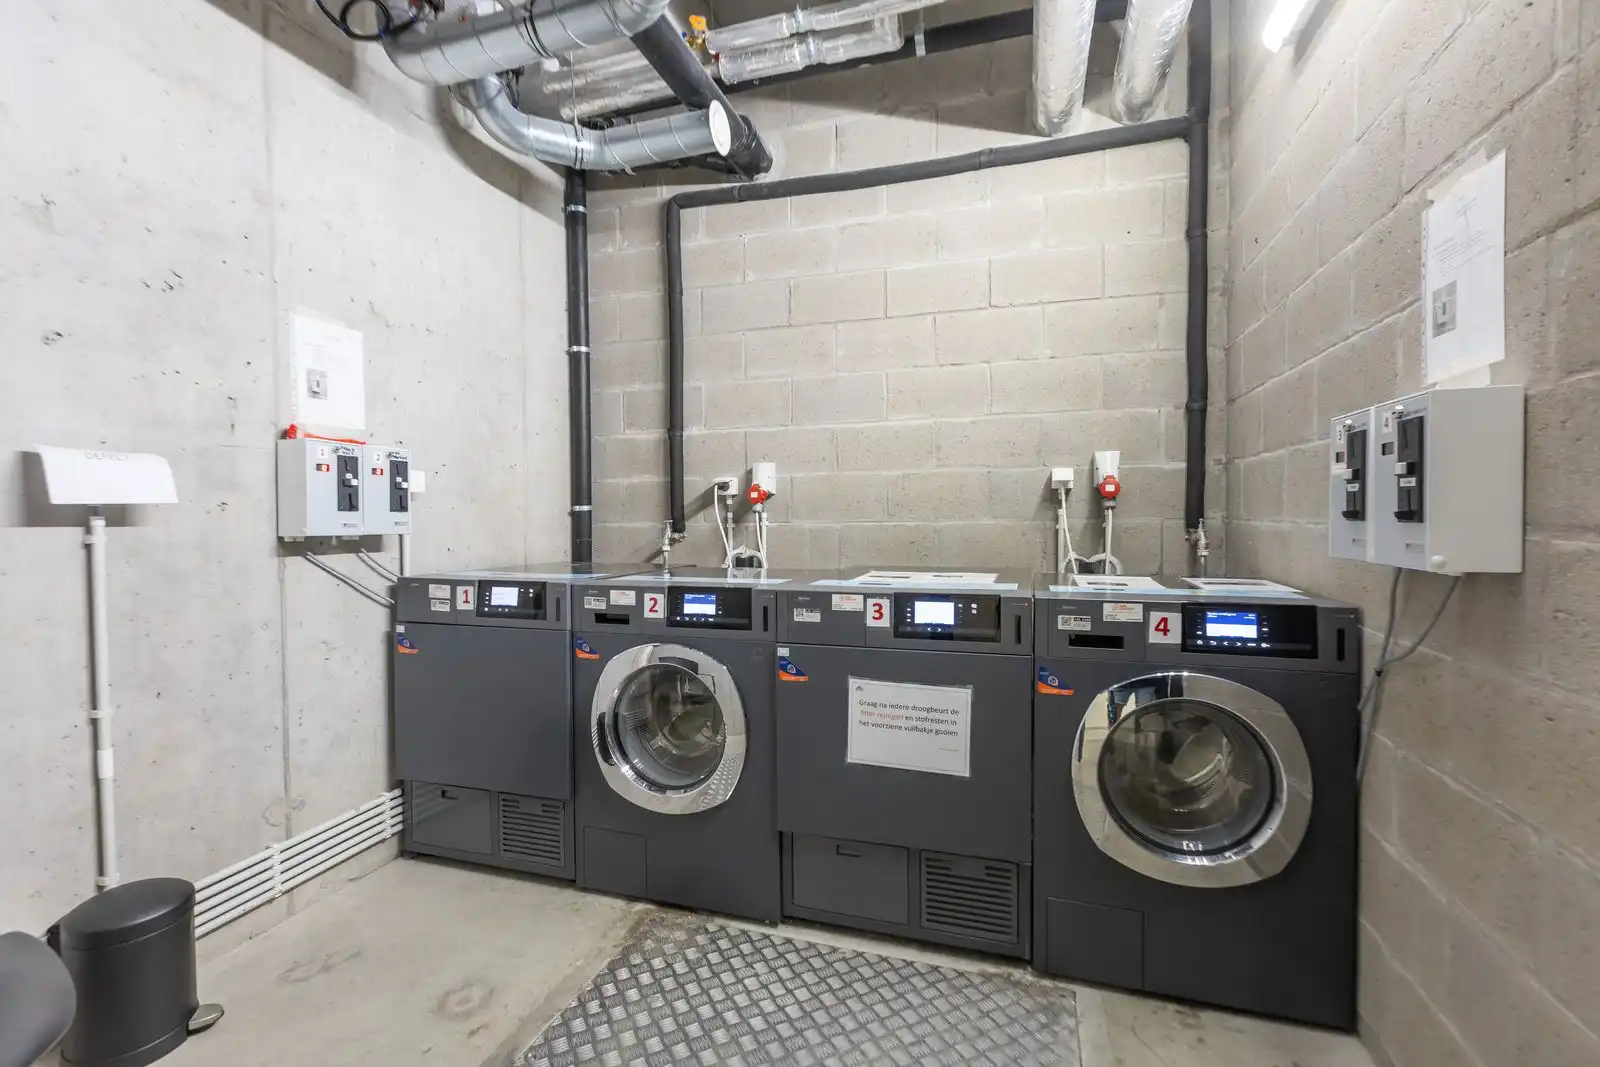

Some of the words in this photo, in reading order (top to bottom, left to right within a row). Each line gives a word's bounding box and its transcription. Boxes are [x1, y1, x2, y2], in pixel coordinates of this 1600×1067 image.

[462, 589, 470, 604] 1
[648, 597, 658, 613] 2
[872, 602, 884, 621] 3
[1154, 616, 1170, 636] 4
[859, 700, 878, 708] Graag
[888, 702, 910, 711] iedere
[911, 704, 949, 714] droogbeurt
[950, 708, 960, 716] de
[914, 715, 949, 725] stofresten
[950, 718, 958, 726] in
[870, 721, 903, 731] voorziene
[903, 725, 934, 735] vuilbakje
[934, 728, 958, 737] gooien
